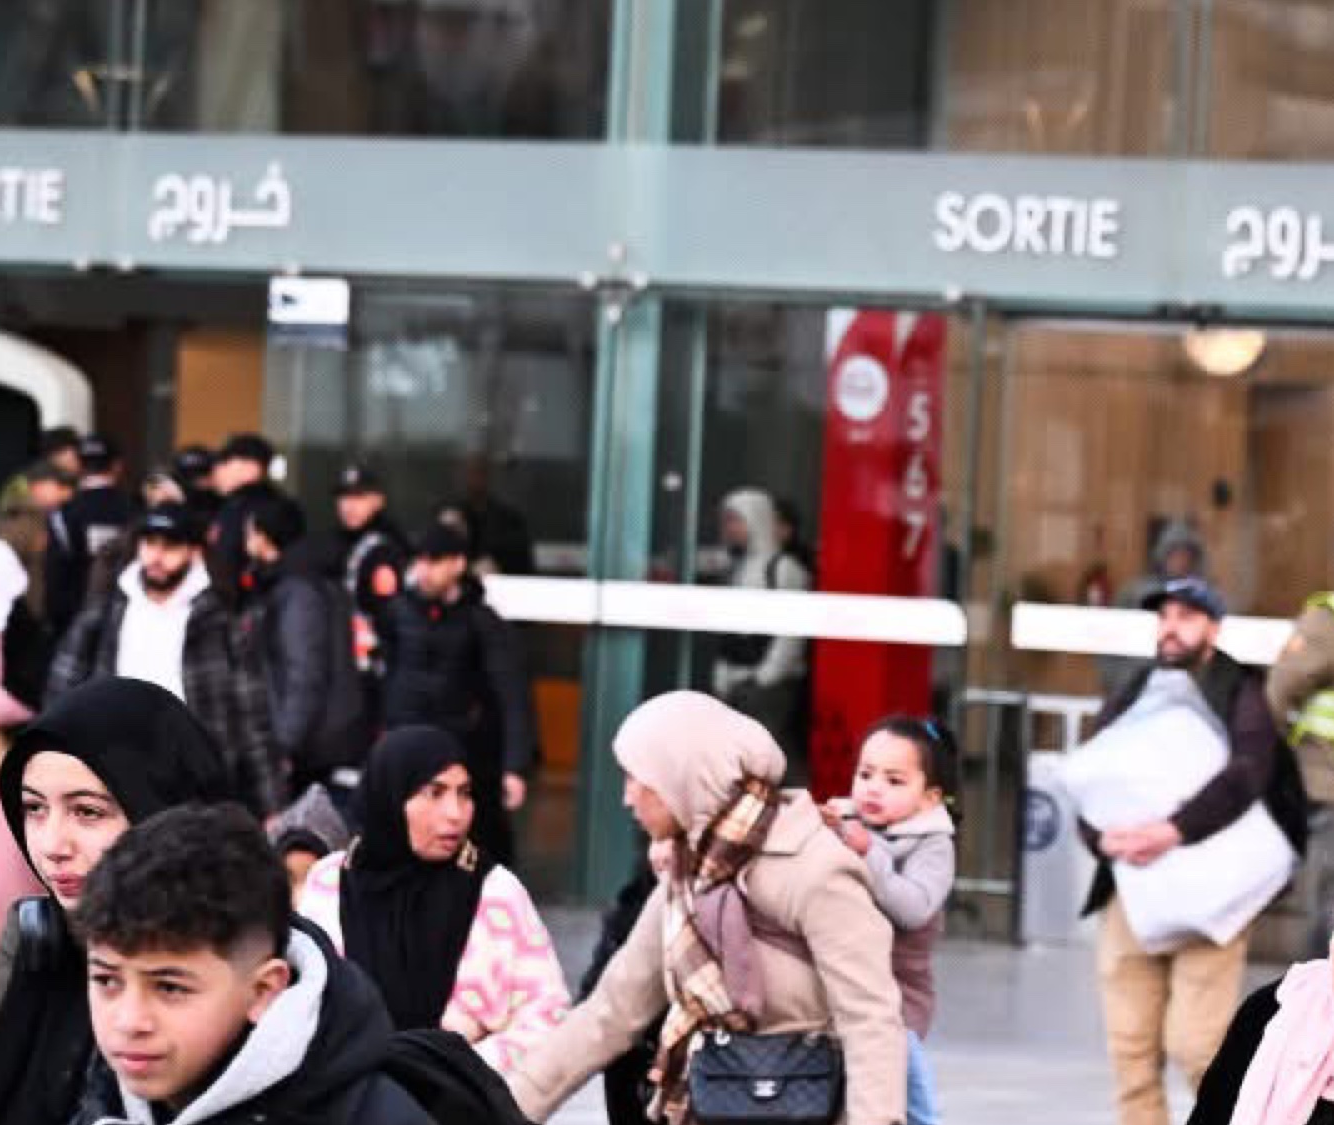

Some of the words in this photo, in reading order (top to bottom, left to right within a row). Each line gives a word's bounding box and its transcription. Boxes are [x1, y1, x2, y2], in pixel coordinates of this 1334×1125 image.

[146, 161, 293, 244] خروج
[932, 190, 1122, 258] SORTIE
[907, 393, 930, 442] 5
[905, 453, 928, 500] 6
[903, 511, 926, 559] 7
